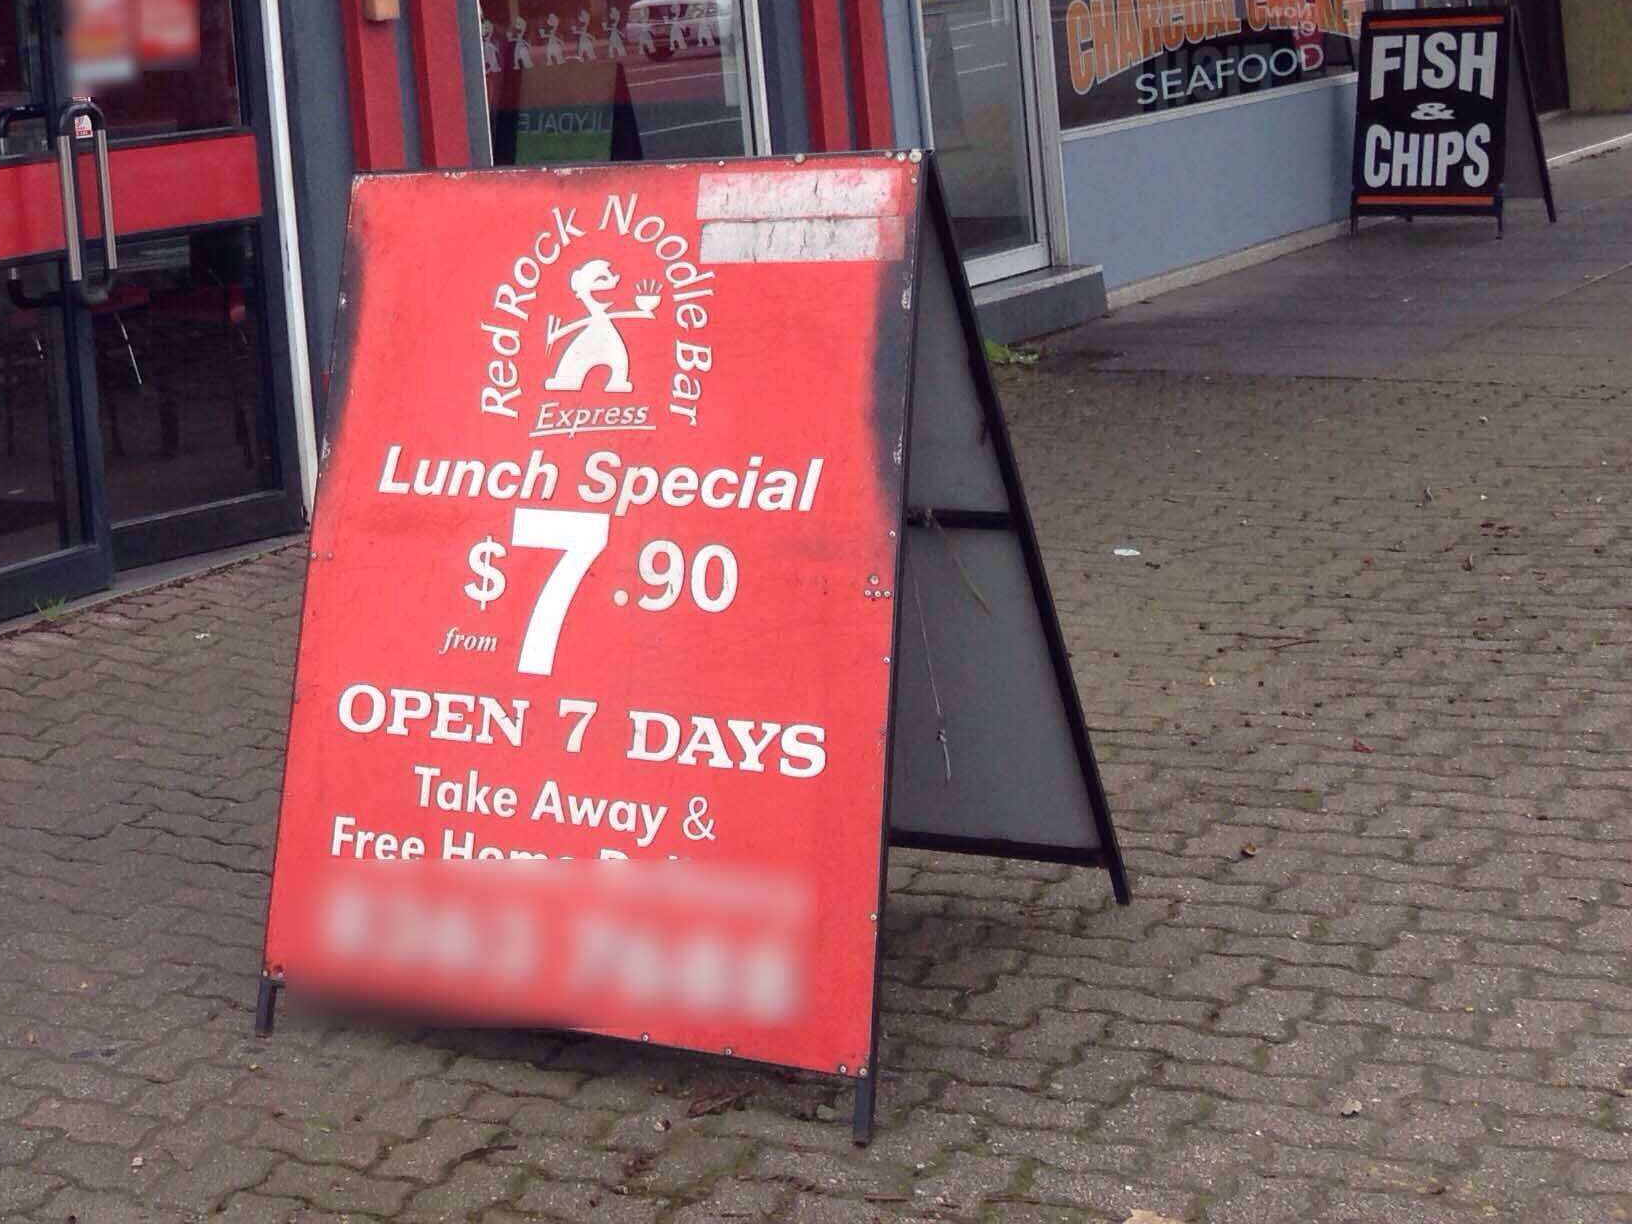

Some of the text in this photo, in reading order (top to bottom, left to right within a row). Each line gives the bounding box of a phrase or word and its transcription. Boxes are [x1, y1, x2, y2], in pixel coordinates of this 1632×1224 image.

[1134, 43, 1325, 106] SEAFOOD
[1369, 31, 1499, 102] FISH
[1410, 102, 1456, 121] &
[1363, 122, 1492, 189] CHIPS
[479, 192, 716, 427] Red Rock Noodle Bar
[534, 401, 650, 439] Express
[377, 443, 825, 517] Lunch Special
[439, 626, 498, 655] from
[337, 682, 828, 778] OPEN 7 DAYS
[331, 815, 576, 860] Free Ho
[414, 765, 716, 847] Take Away &
